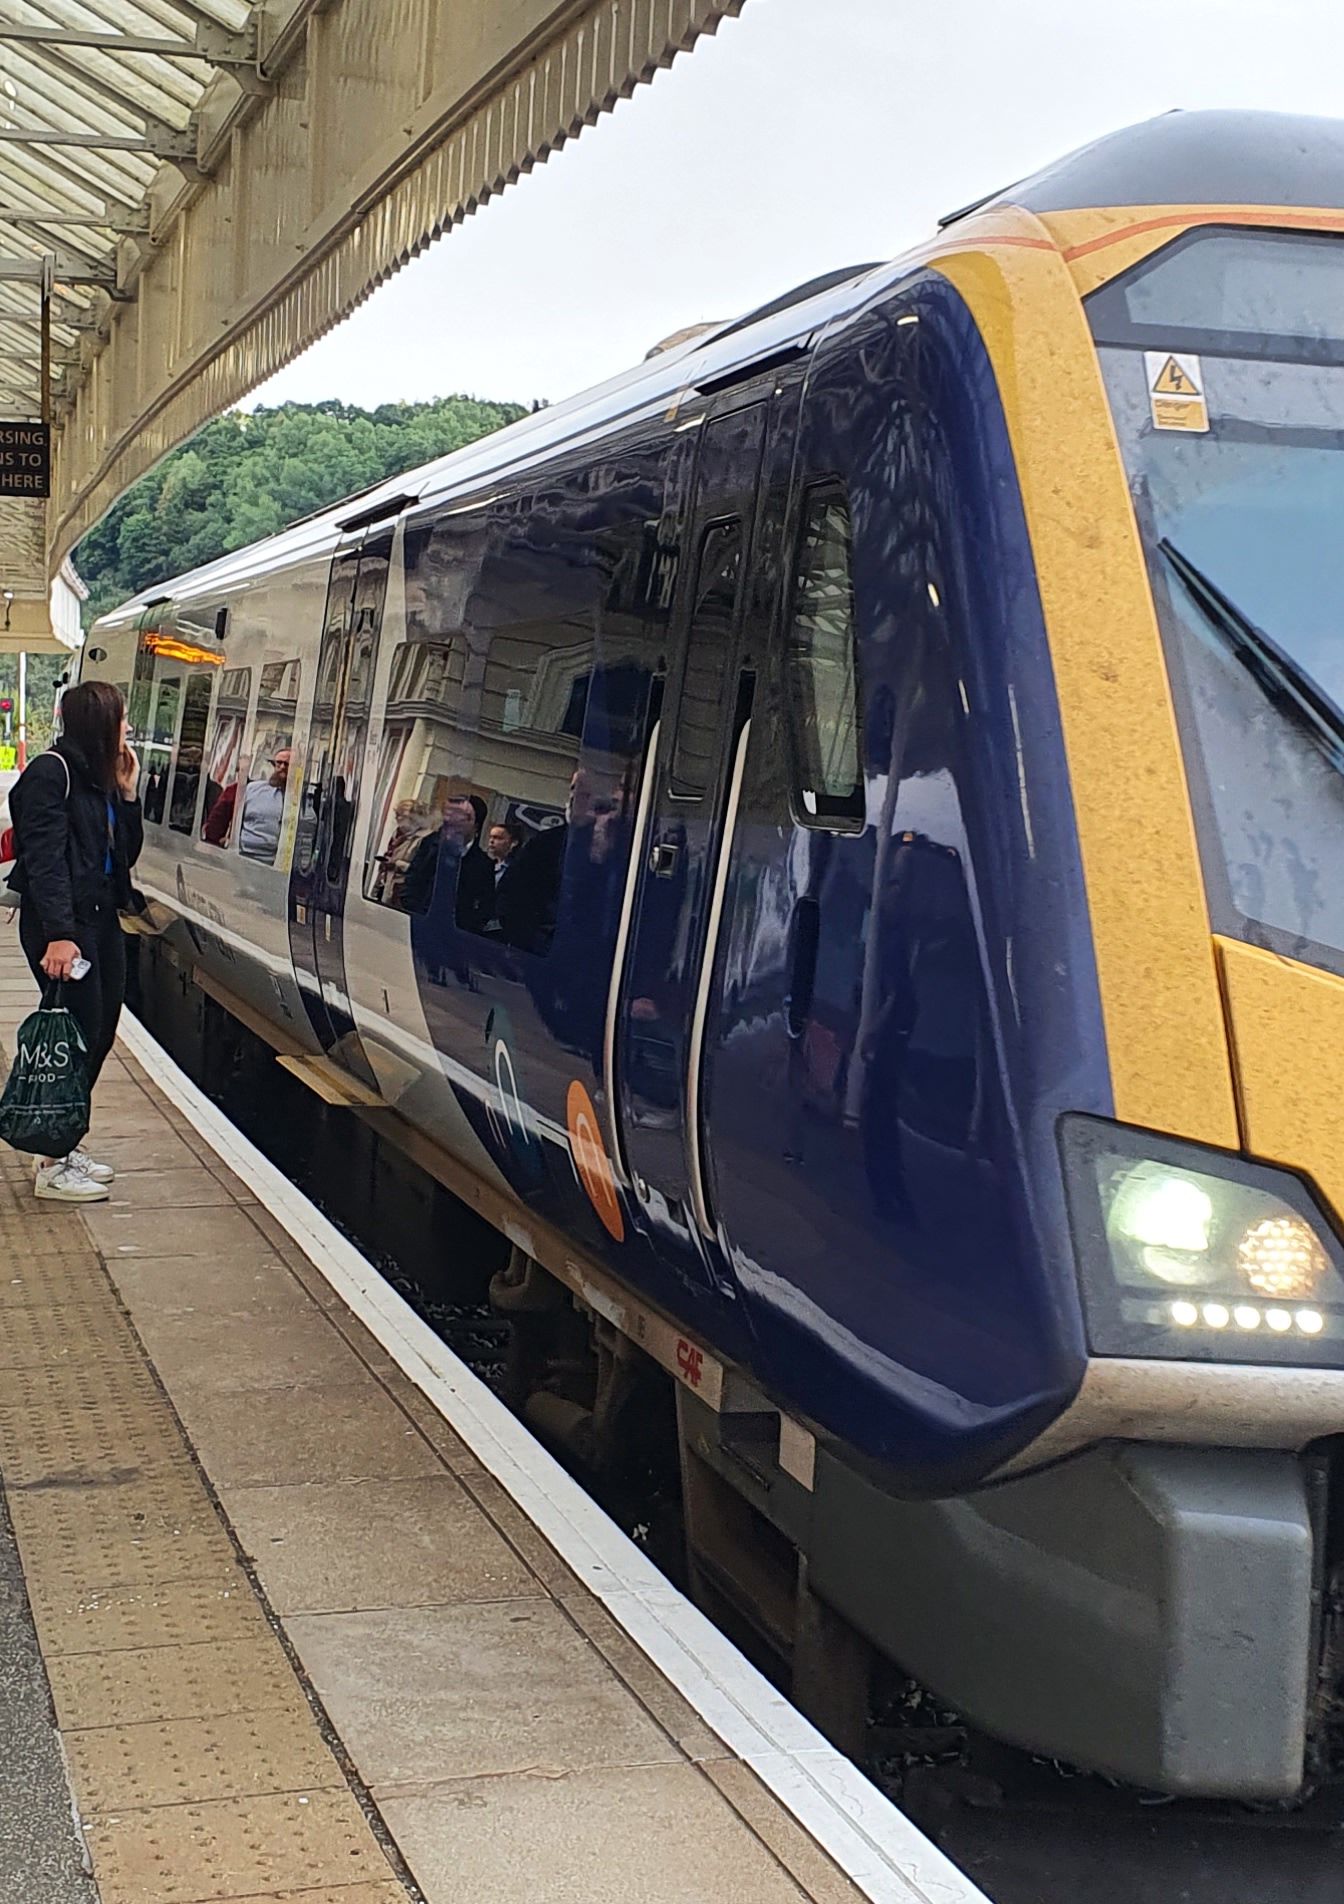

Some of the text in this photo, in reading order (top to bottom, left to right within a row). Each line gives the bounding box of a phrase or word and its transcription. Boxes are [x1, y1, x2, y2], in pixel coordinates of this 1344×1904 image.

[19, 453, 42, 467] TO
[1, 473, 44, 489] HERE
[20, 1041, 69, 1068] M&S
